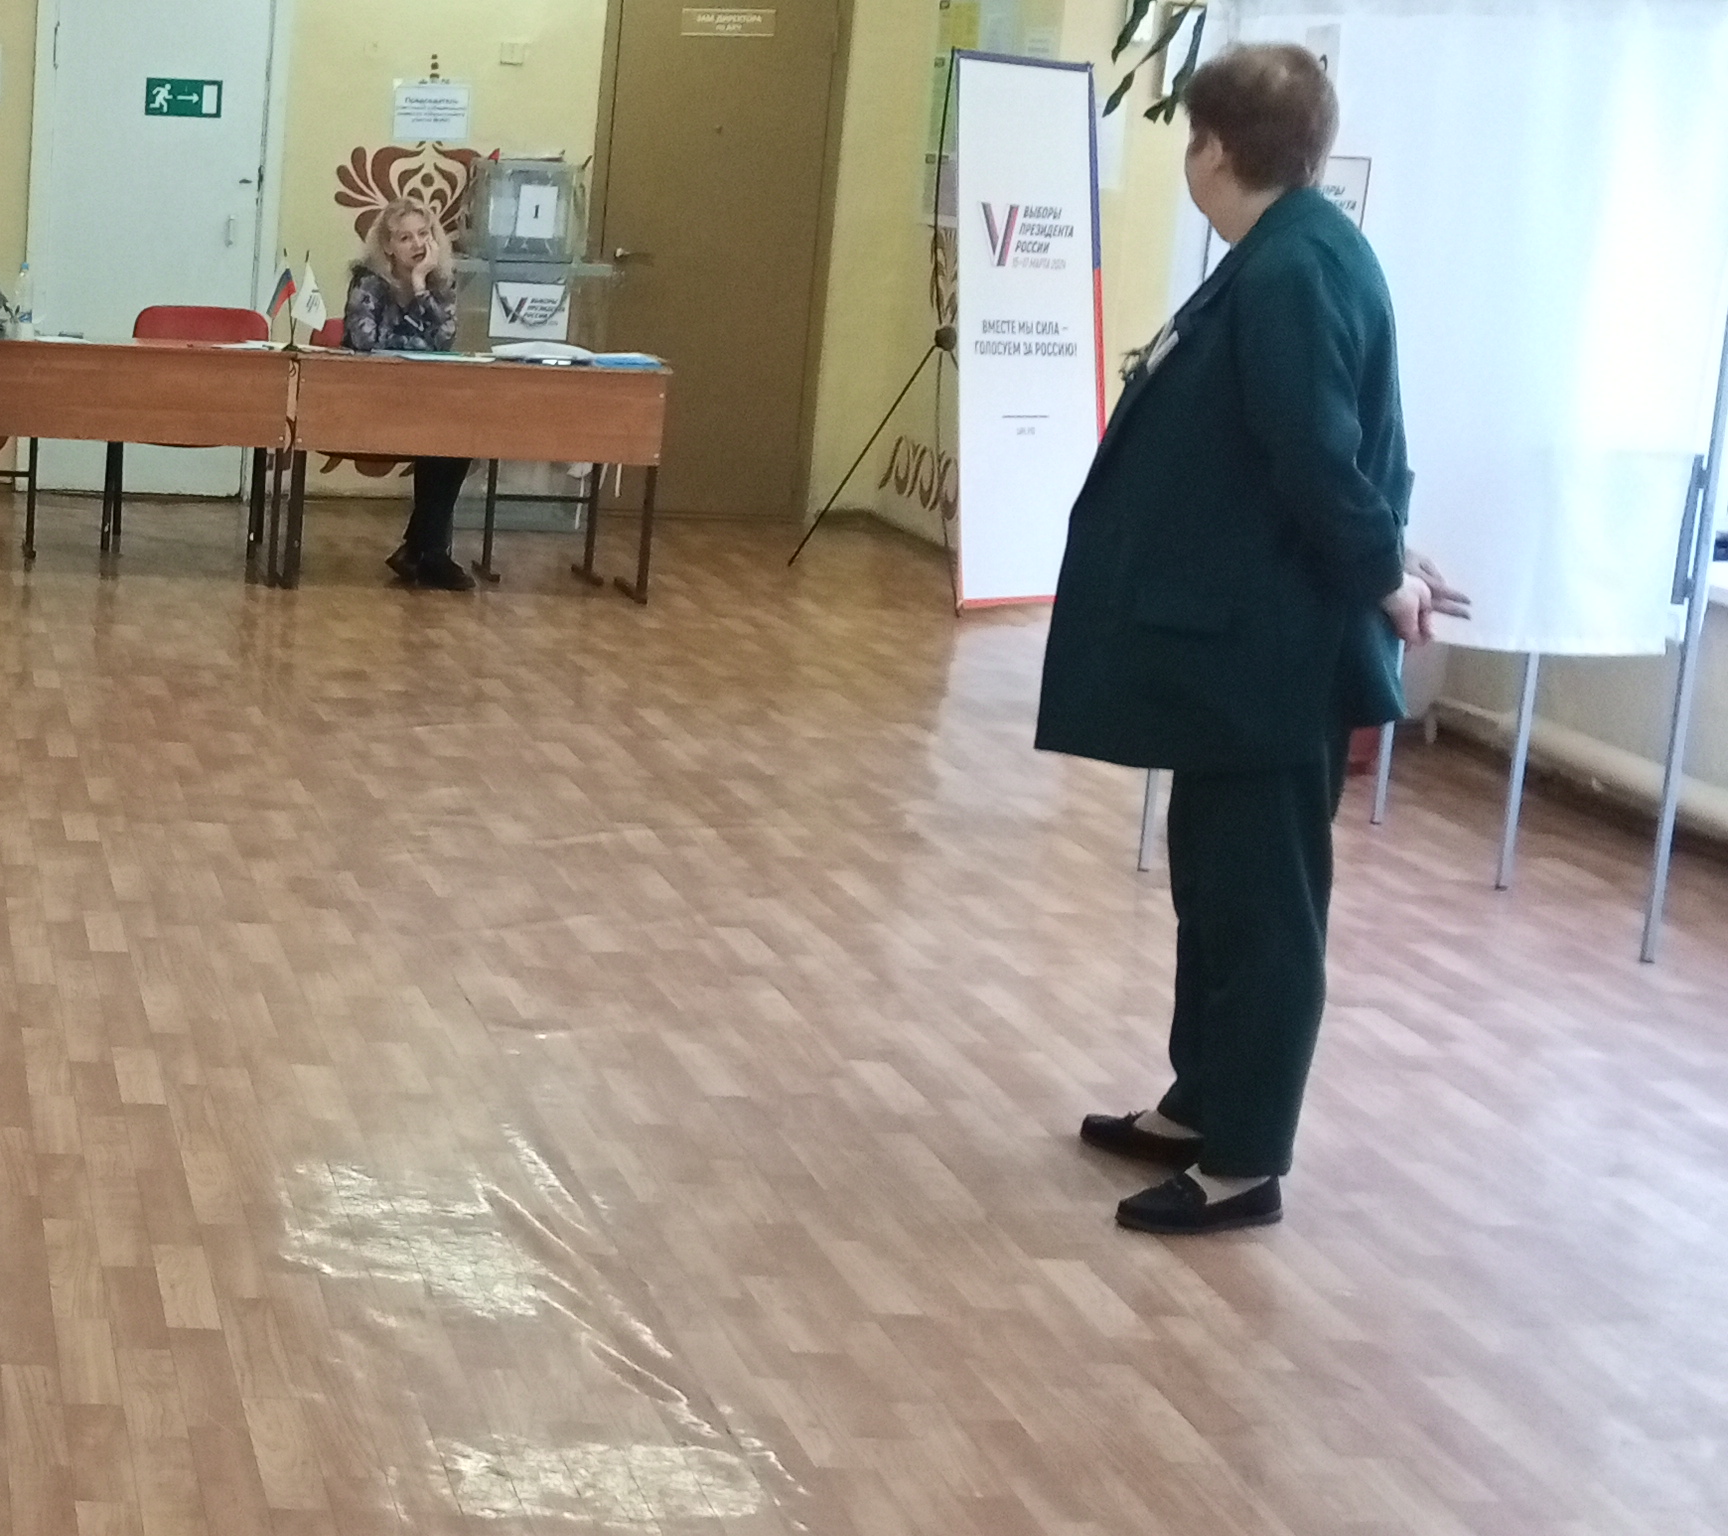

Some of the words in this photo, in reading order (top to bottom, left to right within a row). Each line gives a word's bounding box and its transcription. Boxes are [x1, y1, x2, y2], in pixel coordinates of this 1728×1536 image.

[1023, 205, 1062, 219] ВЫБОРЫ
[1019, 222, 1074, 238] ПРЕЗИДЕНТА
[1015, 241, 1050, 254] РОССИИ
[982, 319, 1016, 335] ВМЕСТЕ
[1018, 320, 1034, 335] МЫ
[1036, 320, 1060, 335] СИЛА
[974, 341, 1021, 356] ГОЛОСУЕМ
[1023, 341, 1033, 355] ЗА
[1035, 341, 1077, 357] РОССИЮ!
